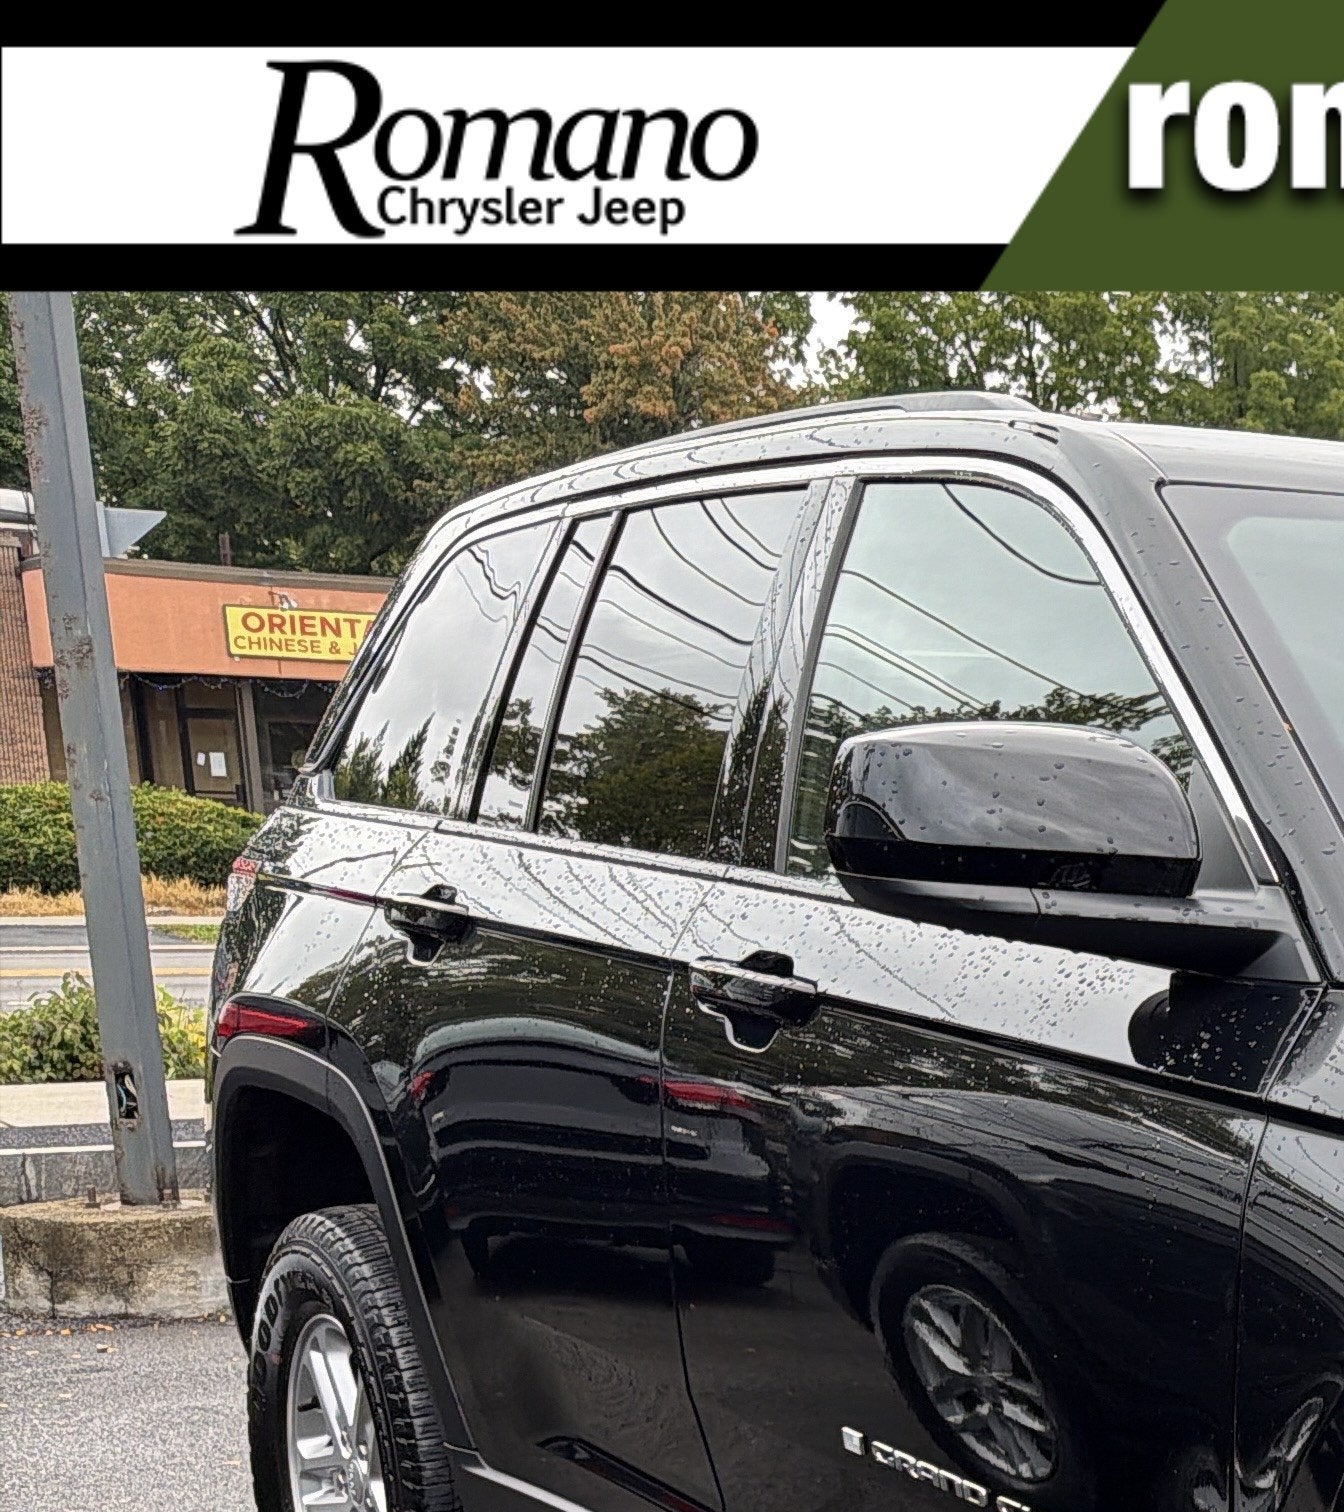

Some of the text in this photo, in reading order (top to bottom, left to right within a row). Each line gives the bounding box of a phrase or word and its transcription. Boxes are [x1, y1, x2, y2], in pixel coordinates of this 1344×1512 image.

[233, 635, 323, 654] CHINESE
[328, 640, 341, 655] &
[870, 1440, 989, 1508] GRAND
